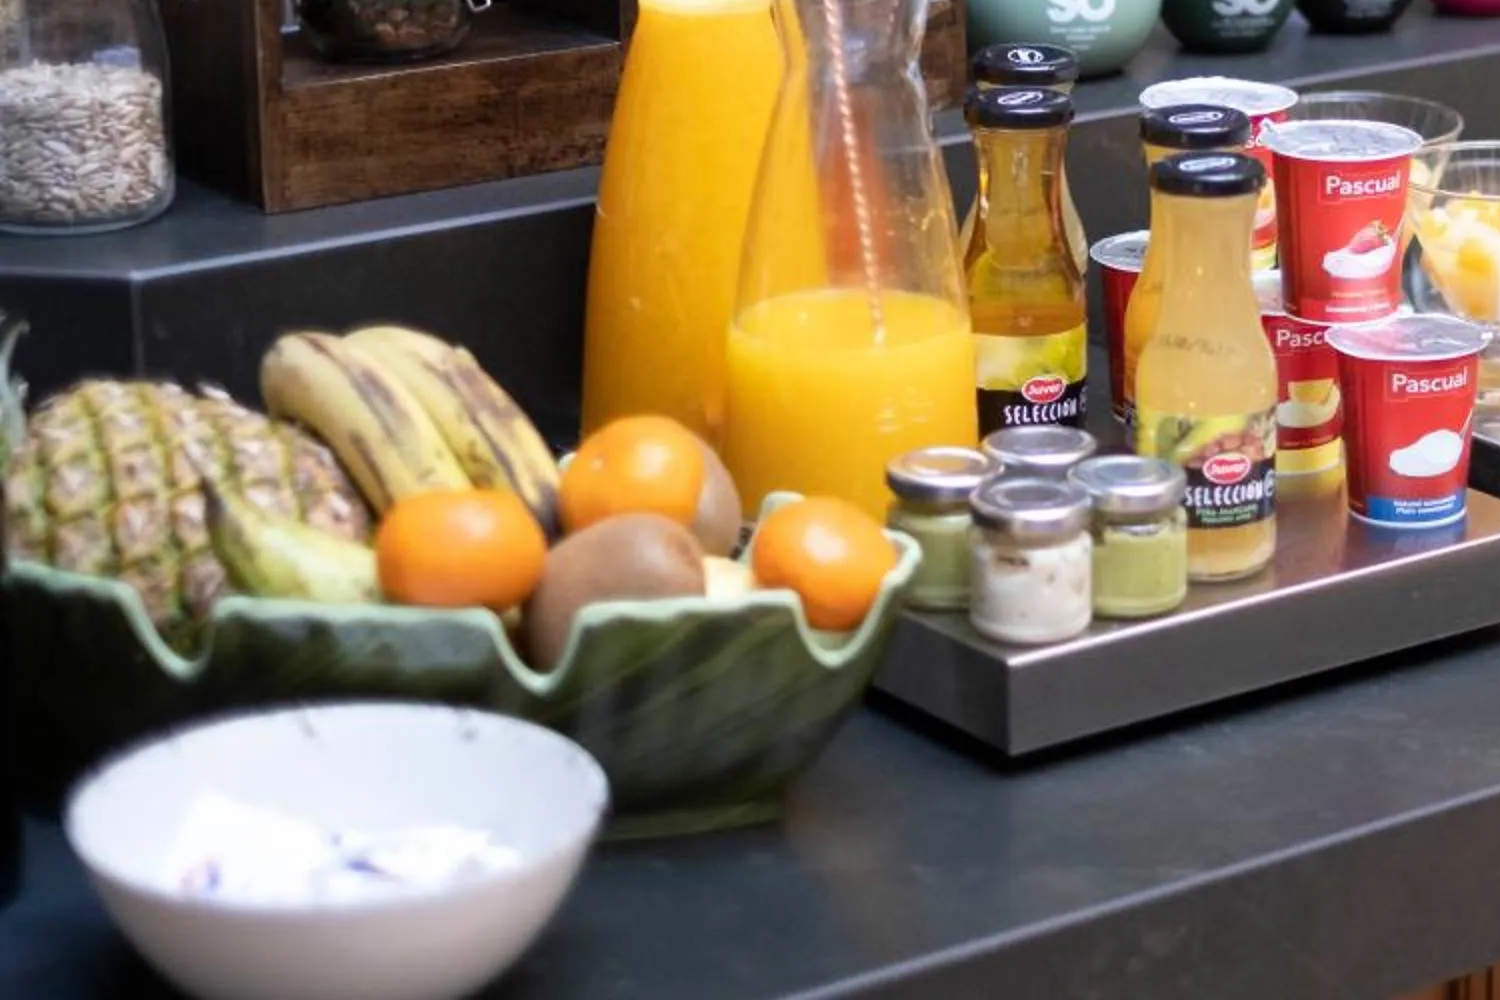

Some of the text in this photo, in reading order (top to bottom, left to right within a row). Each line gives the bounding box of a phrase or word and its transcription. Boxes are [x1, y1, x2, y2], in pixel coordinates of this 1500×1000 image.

[1325, 169, 1401, 195] Pascual
[1275, 328, 1327, 348] Pasc
[1392, 366, 1469, 394] Pascual
